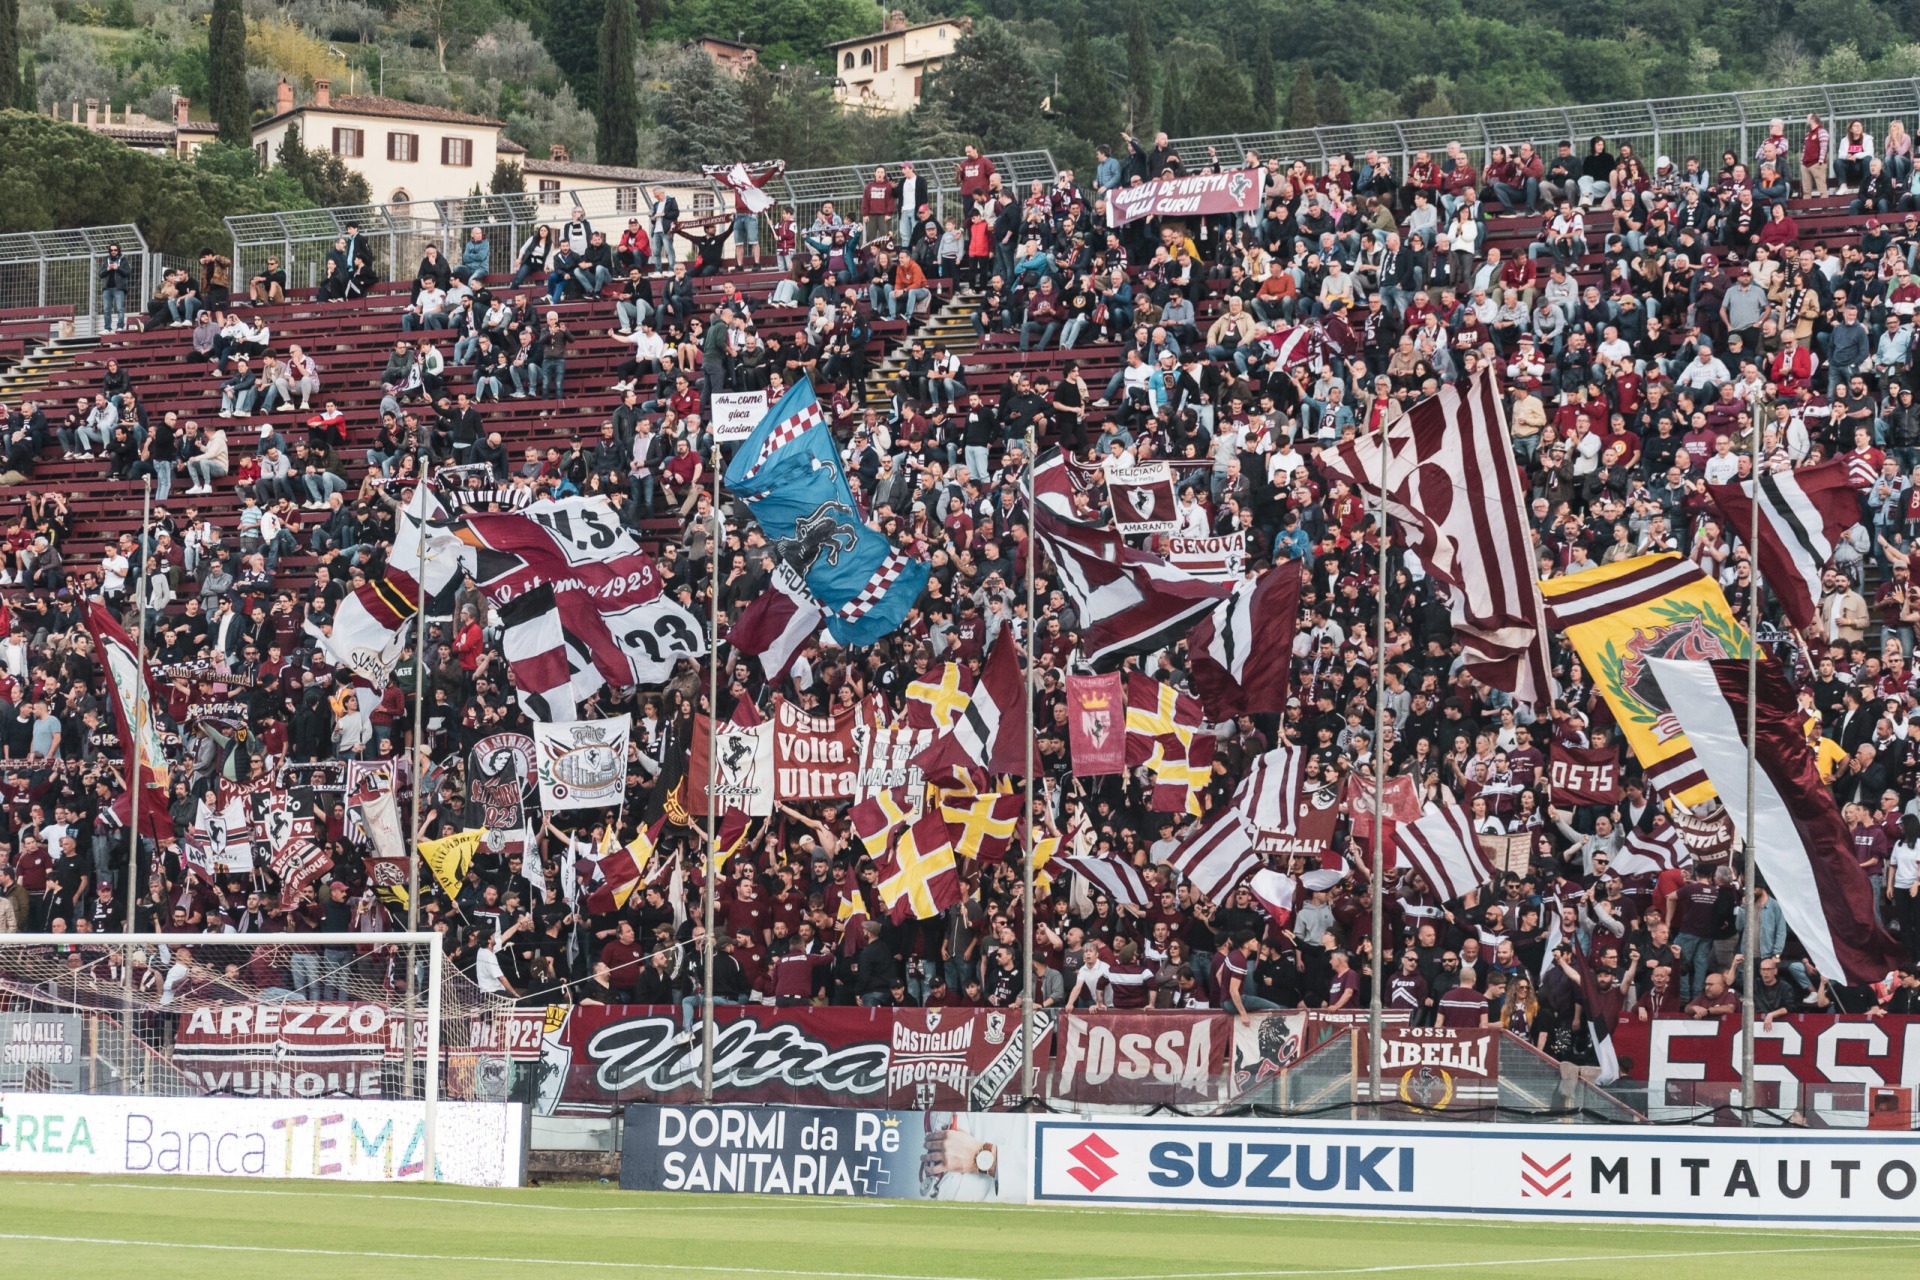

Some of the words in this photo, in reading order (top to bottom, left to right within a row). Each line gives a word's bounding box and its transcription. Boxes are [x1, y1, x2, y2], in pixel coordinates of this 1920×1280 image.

[1115, 182, 1158, 204] QUELLI
[1125, 197, 1155, 220] ALLA
[1156, 194, 1202, 212] CURVA
[737, 394, 763, 405] come
[728, 410, 750, 422] gioca
[1110, 464, 1164, 477] MELICIANO
[1123, 522, 1174, 533] AMARANTO
[1169, 534, 1244, 555] GENOVA
[601, 565, 653, 598] 1923
[624, 614, 698, 664] 23
[778, 701, 835, 734] Ogni
[777, 732, 852, 764] Volta,
[1551, 762, 1613, 792] 0575
[12, 1021, 32, 1042] NO
[34, 1022, 64, 1042] ALLE
[186, 1004, 387, 1035] AREZZO
[1319, 1013, 1354, 1023] FOSSA
[1399, 1028, 1458, 1038] FOSSA
[892, 1017, 975, 1052] CASTIGLION
[1058, 1014, 1213, 1098] FOSSA
[887, 1061, 969, 1098] FIBOCCHI
[658, 1108, 785, 1148] DORMI
[801, 1117, 838, 1151] da
[663, 1152, 856, 1197] SANITARIA
[1147, 1141, 1415, 1193] SUZUKI
[1590, 1156, 1918, 1200] MITAUTO
